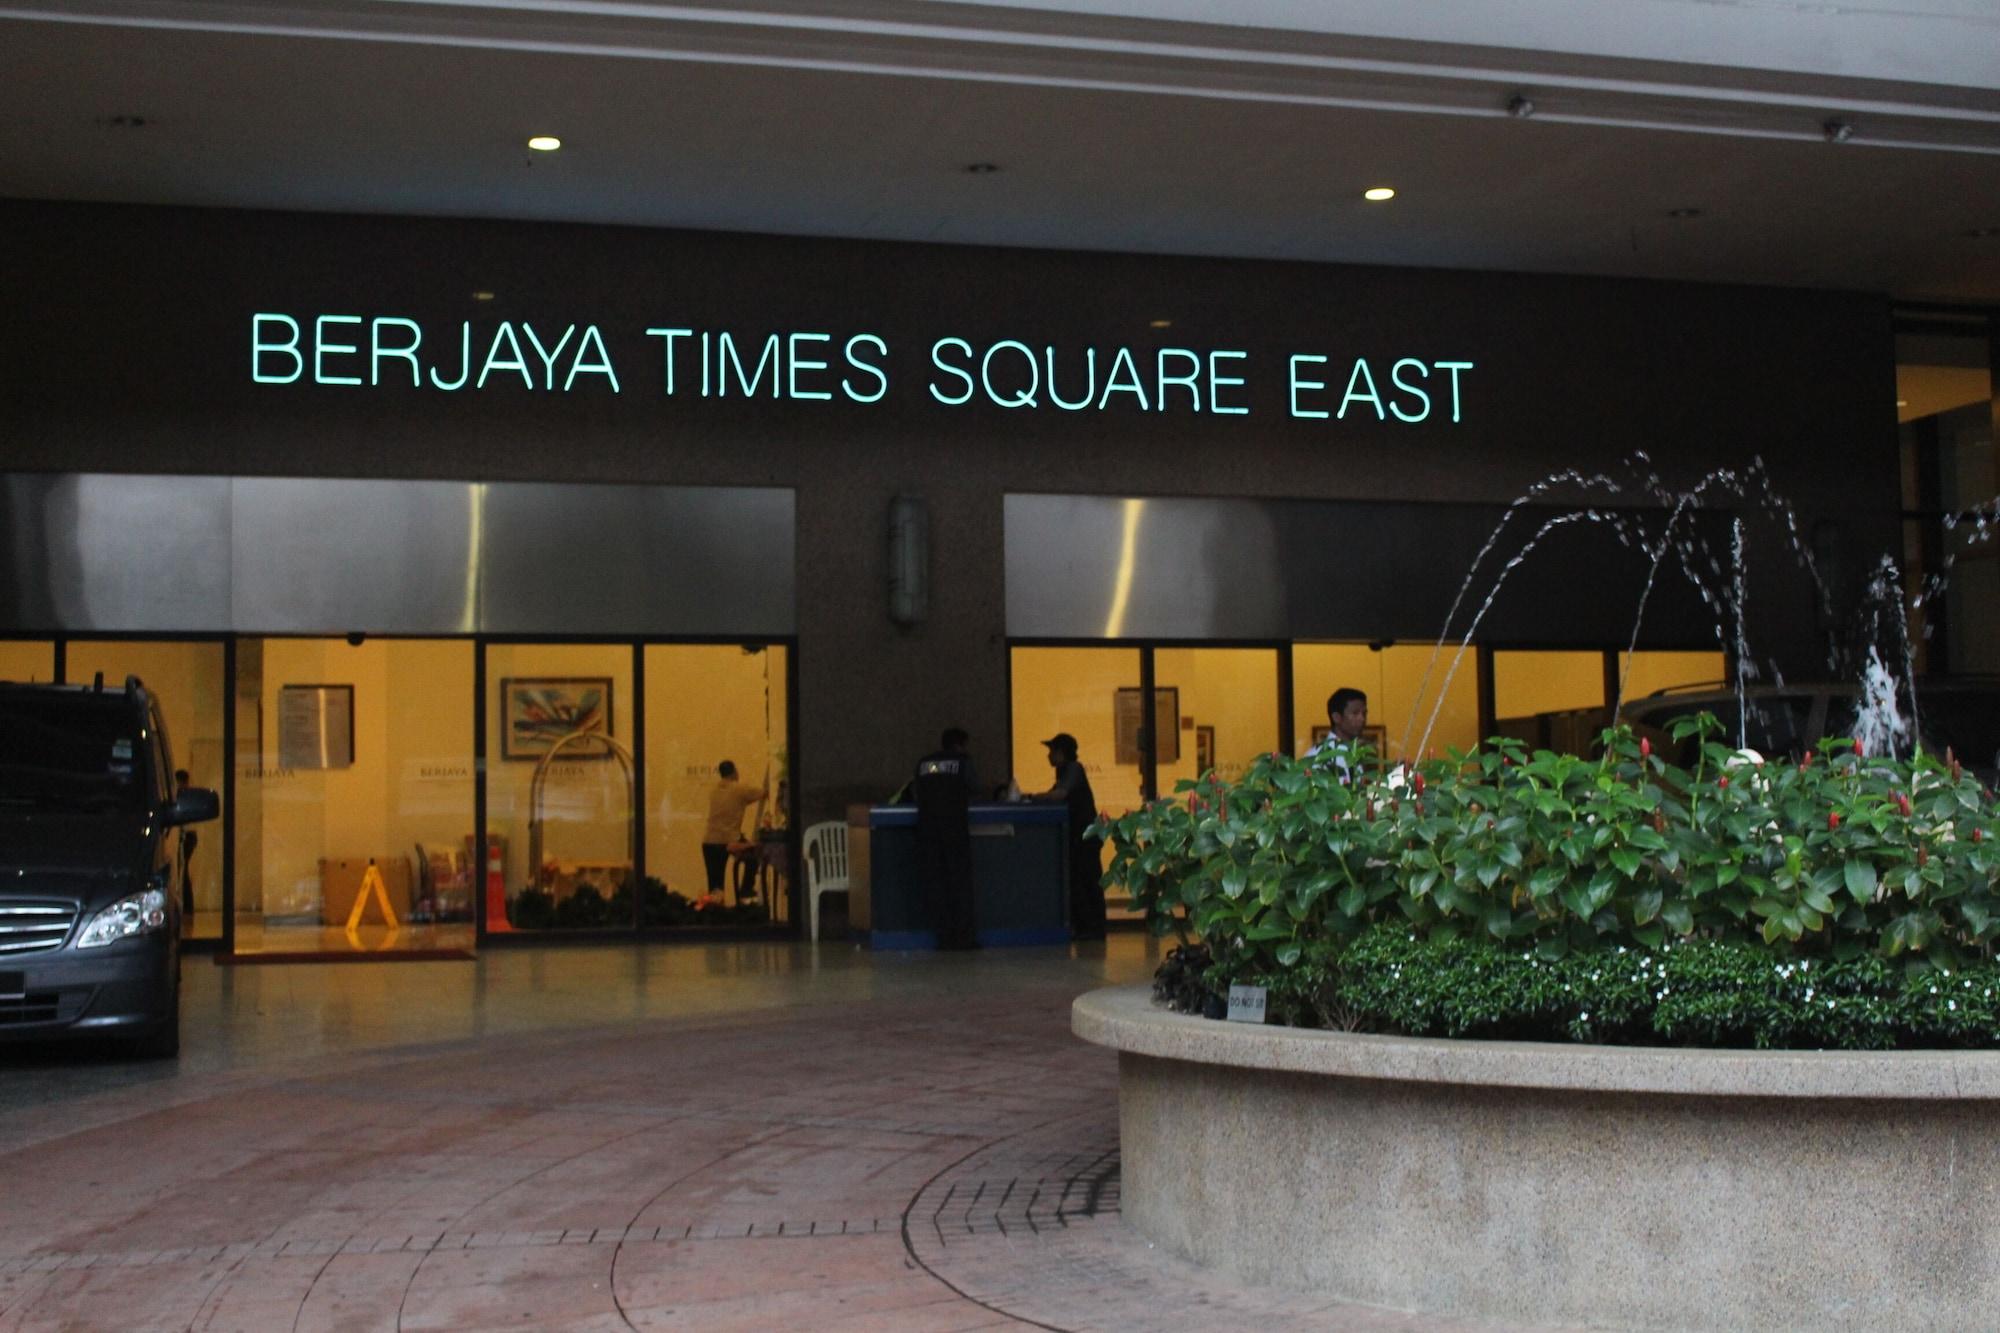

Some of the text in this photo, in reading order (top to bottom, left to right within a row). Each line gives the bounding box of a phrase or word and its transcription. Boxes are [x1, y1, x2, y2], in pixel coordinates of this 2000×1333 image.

[251, 312, 1474, 423] BERJAYA TIMES SQUARE EAST
[245, 768, 295, 779] BERJAYA
[420, 767, 468, 778] BERJAYA
[1230, 996, 1240, 1008] DO
